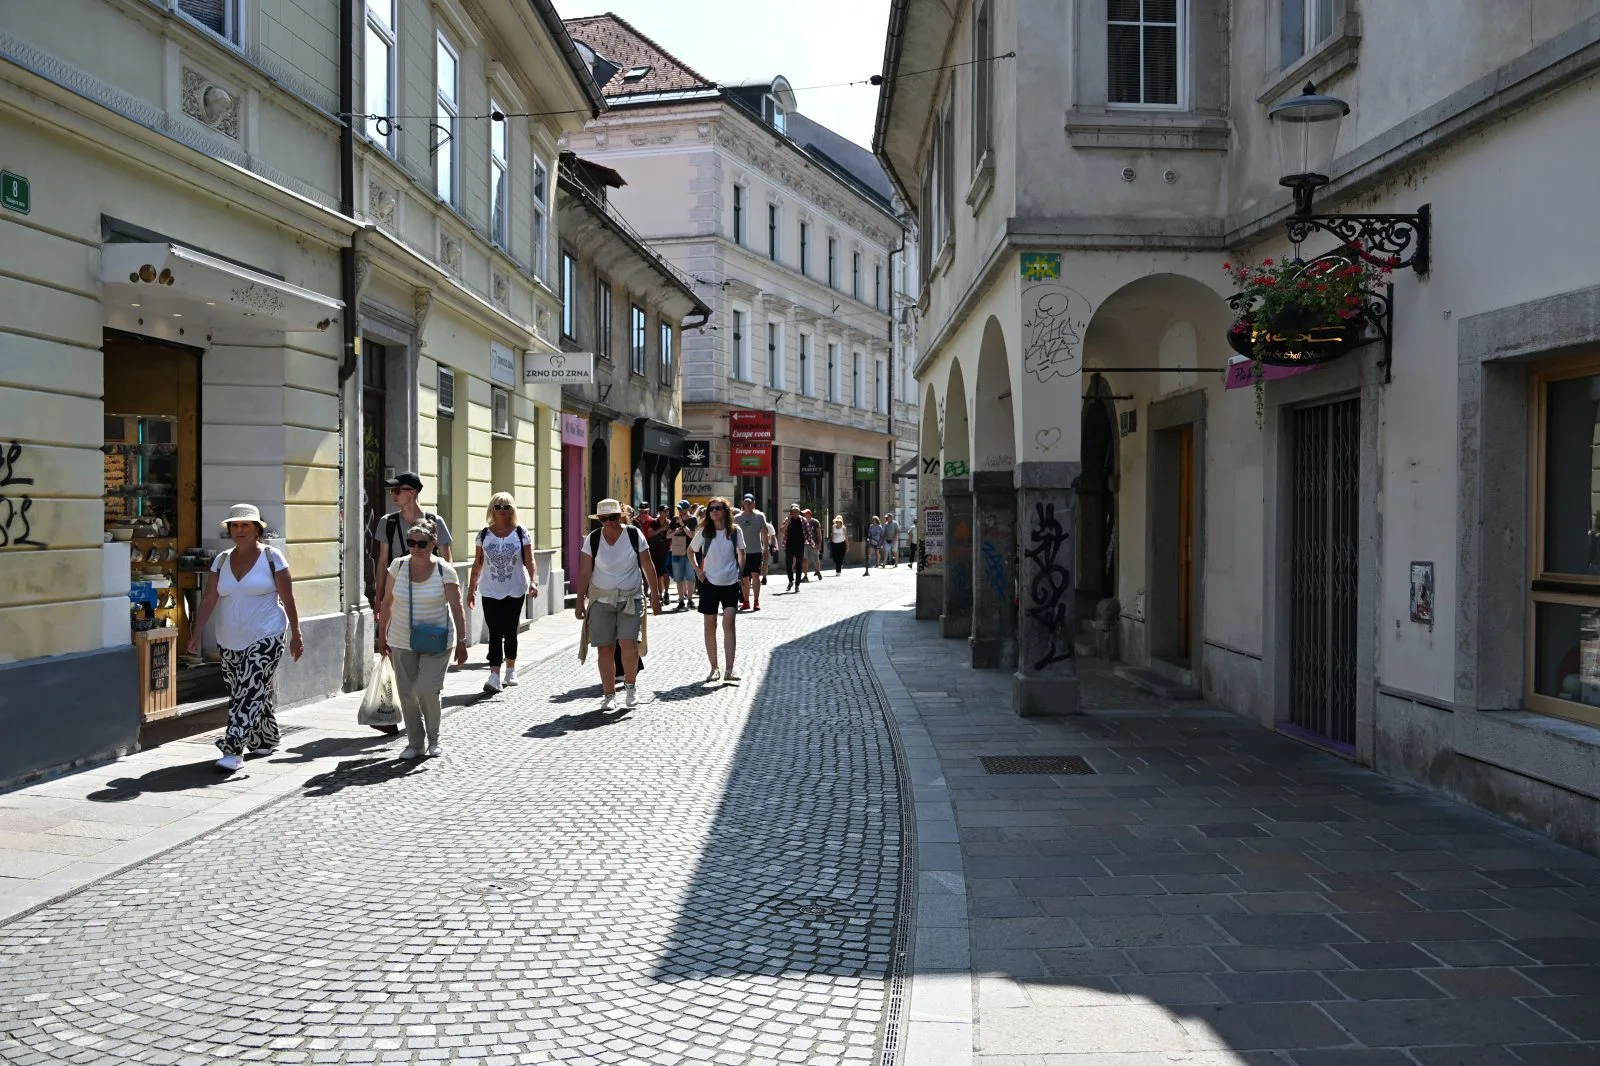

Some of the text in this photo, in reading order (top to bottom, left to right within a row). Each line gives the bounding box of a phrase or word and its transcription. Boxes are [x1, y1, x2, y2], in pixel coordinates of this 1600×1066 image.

[12, 180, 18, 198] 8
[526, 369, 589, 377] ZRNO DO ZRNA
[732, 430, 753, 439] Escape
